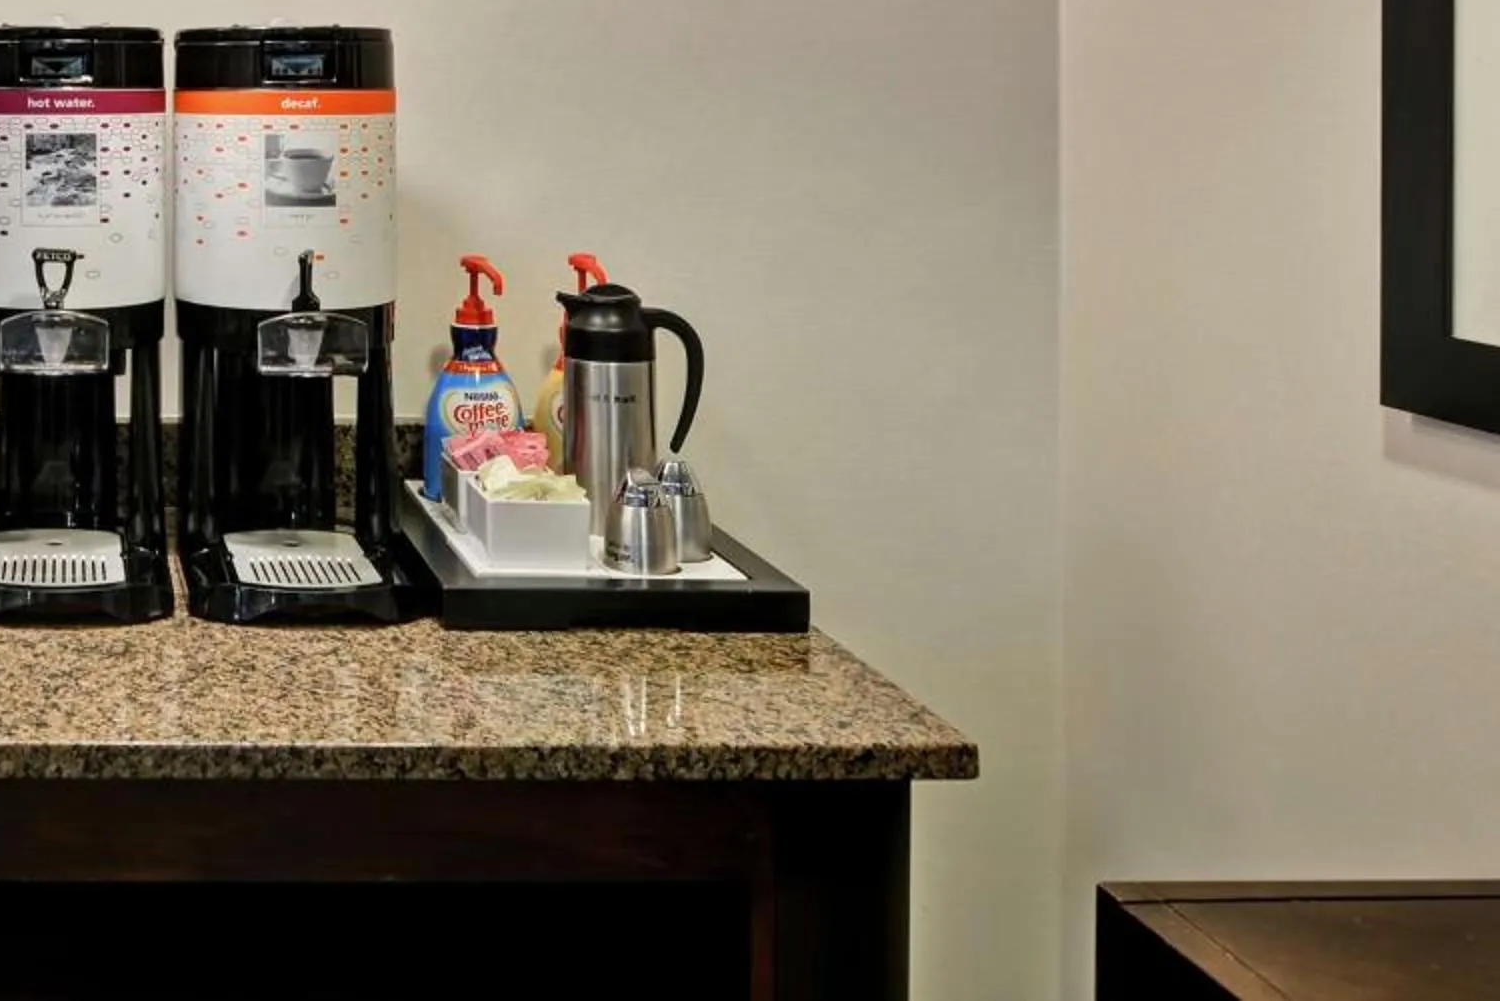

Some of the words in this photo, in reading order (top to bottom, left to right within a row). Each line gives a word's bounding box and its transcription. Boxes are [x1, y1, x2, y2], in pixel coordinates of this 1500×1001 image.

[27, 97, 50, 108] hot
[53, 98, 95, 108] water.
[281, 97, 321, 109] decaf.
